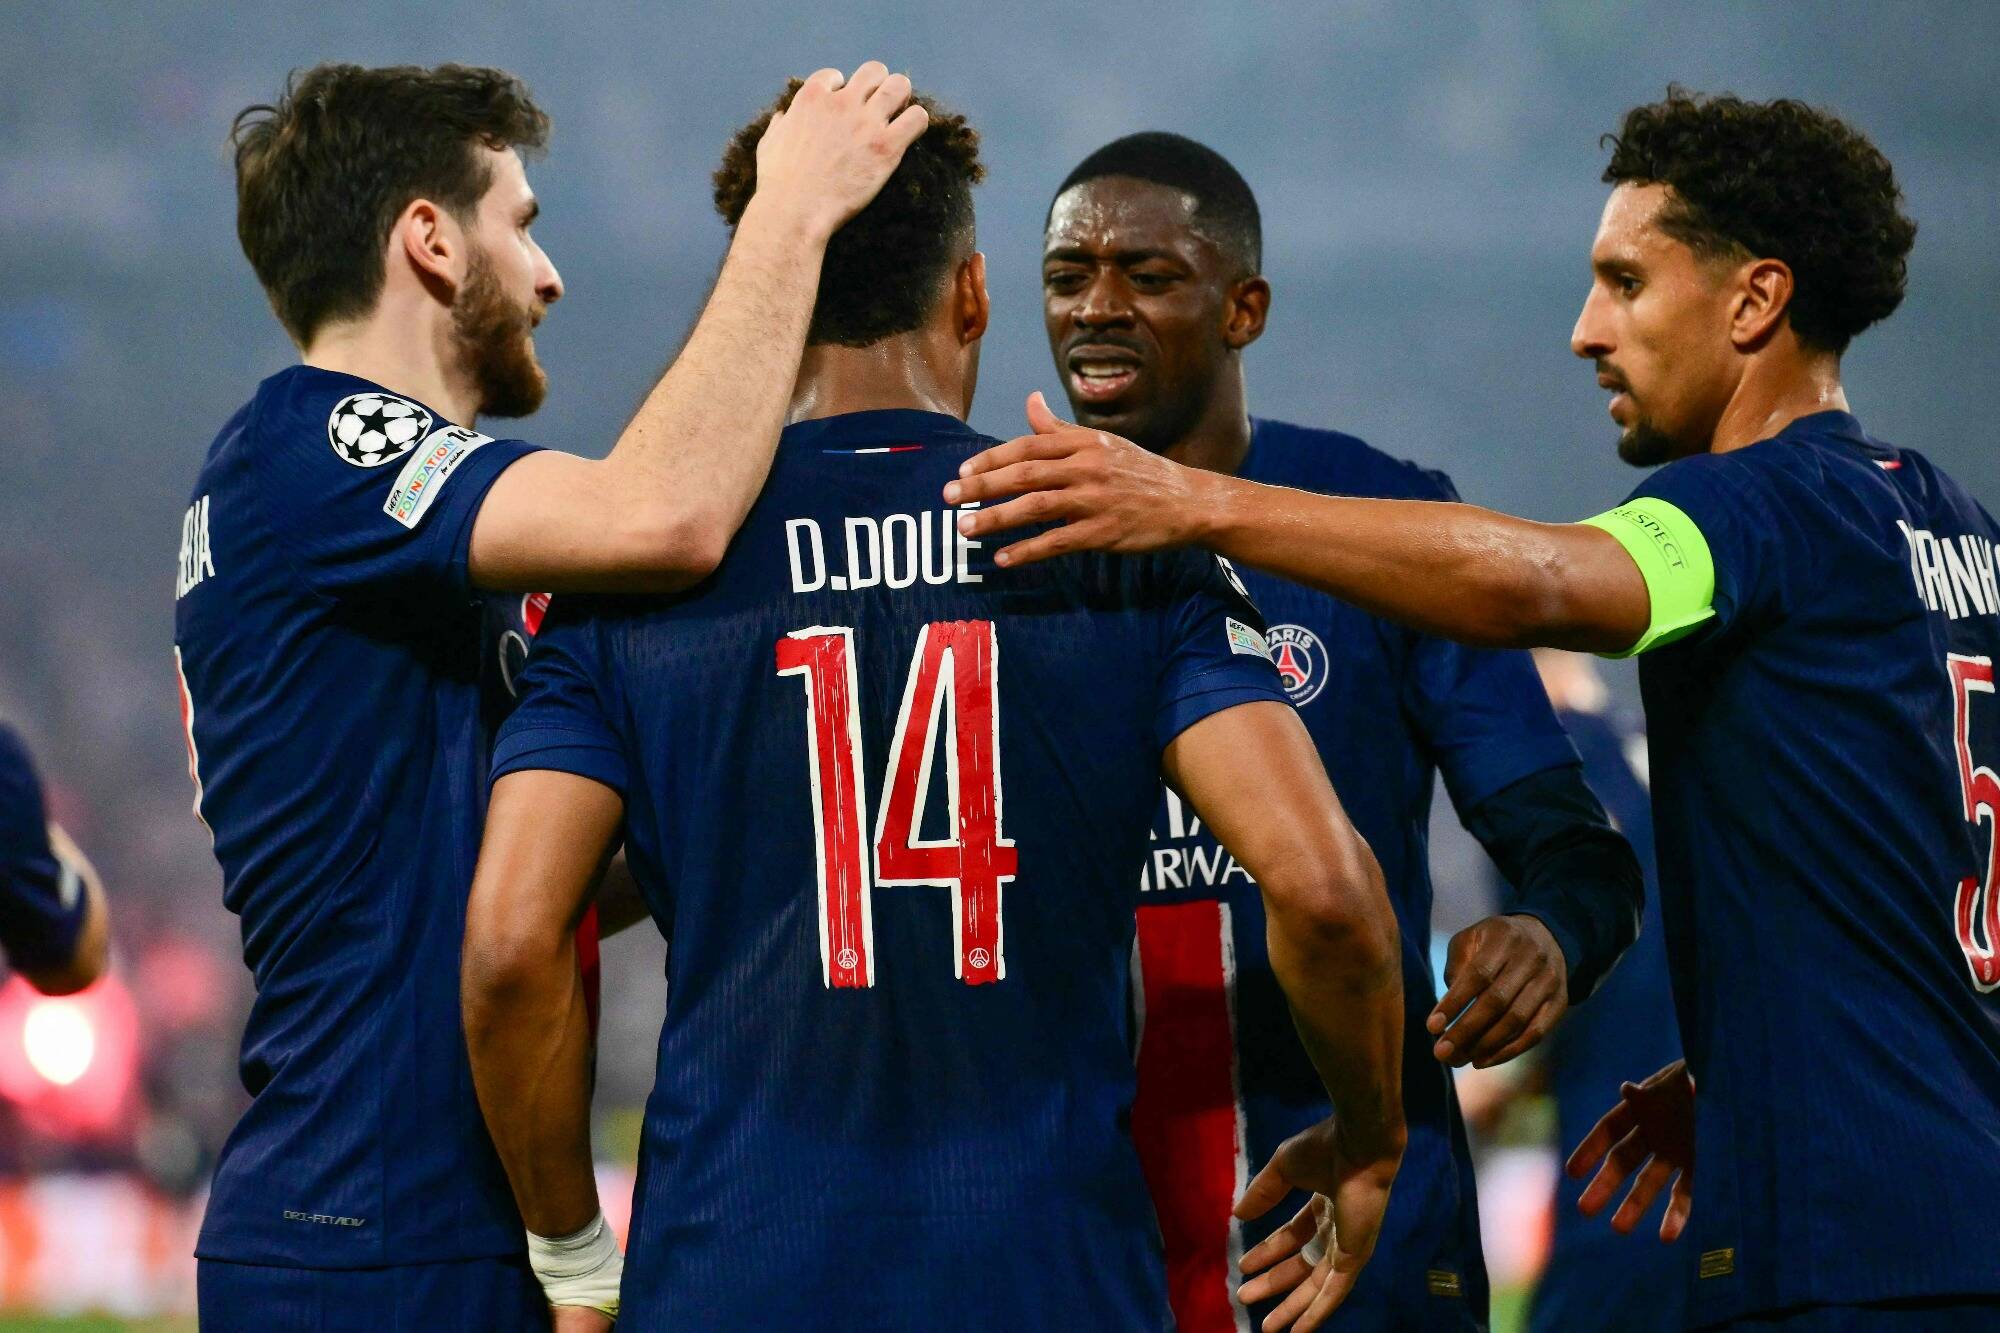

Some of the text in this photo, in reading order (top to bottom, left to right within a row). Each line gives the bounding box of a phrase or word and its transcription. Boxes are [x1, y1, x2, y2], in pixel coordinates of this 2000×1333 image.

[387, 489, 402, 511] UEFA
[396, 439, 456, 519] FOUNDATION
[775, 619, 1018, 990] 14
[1947, 651, 2000, 993] 5
[1140, 844, 1257, 892] IRWA
